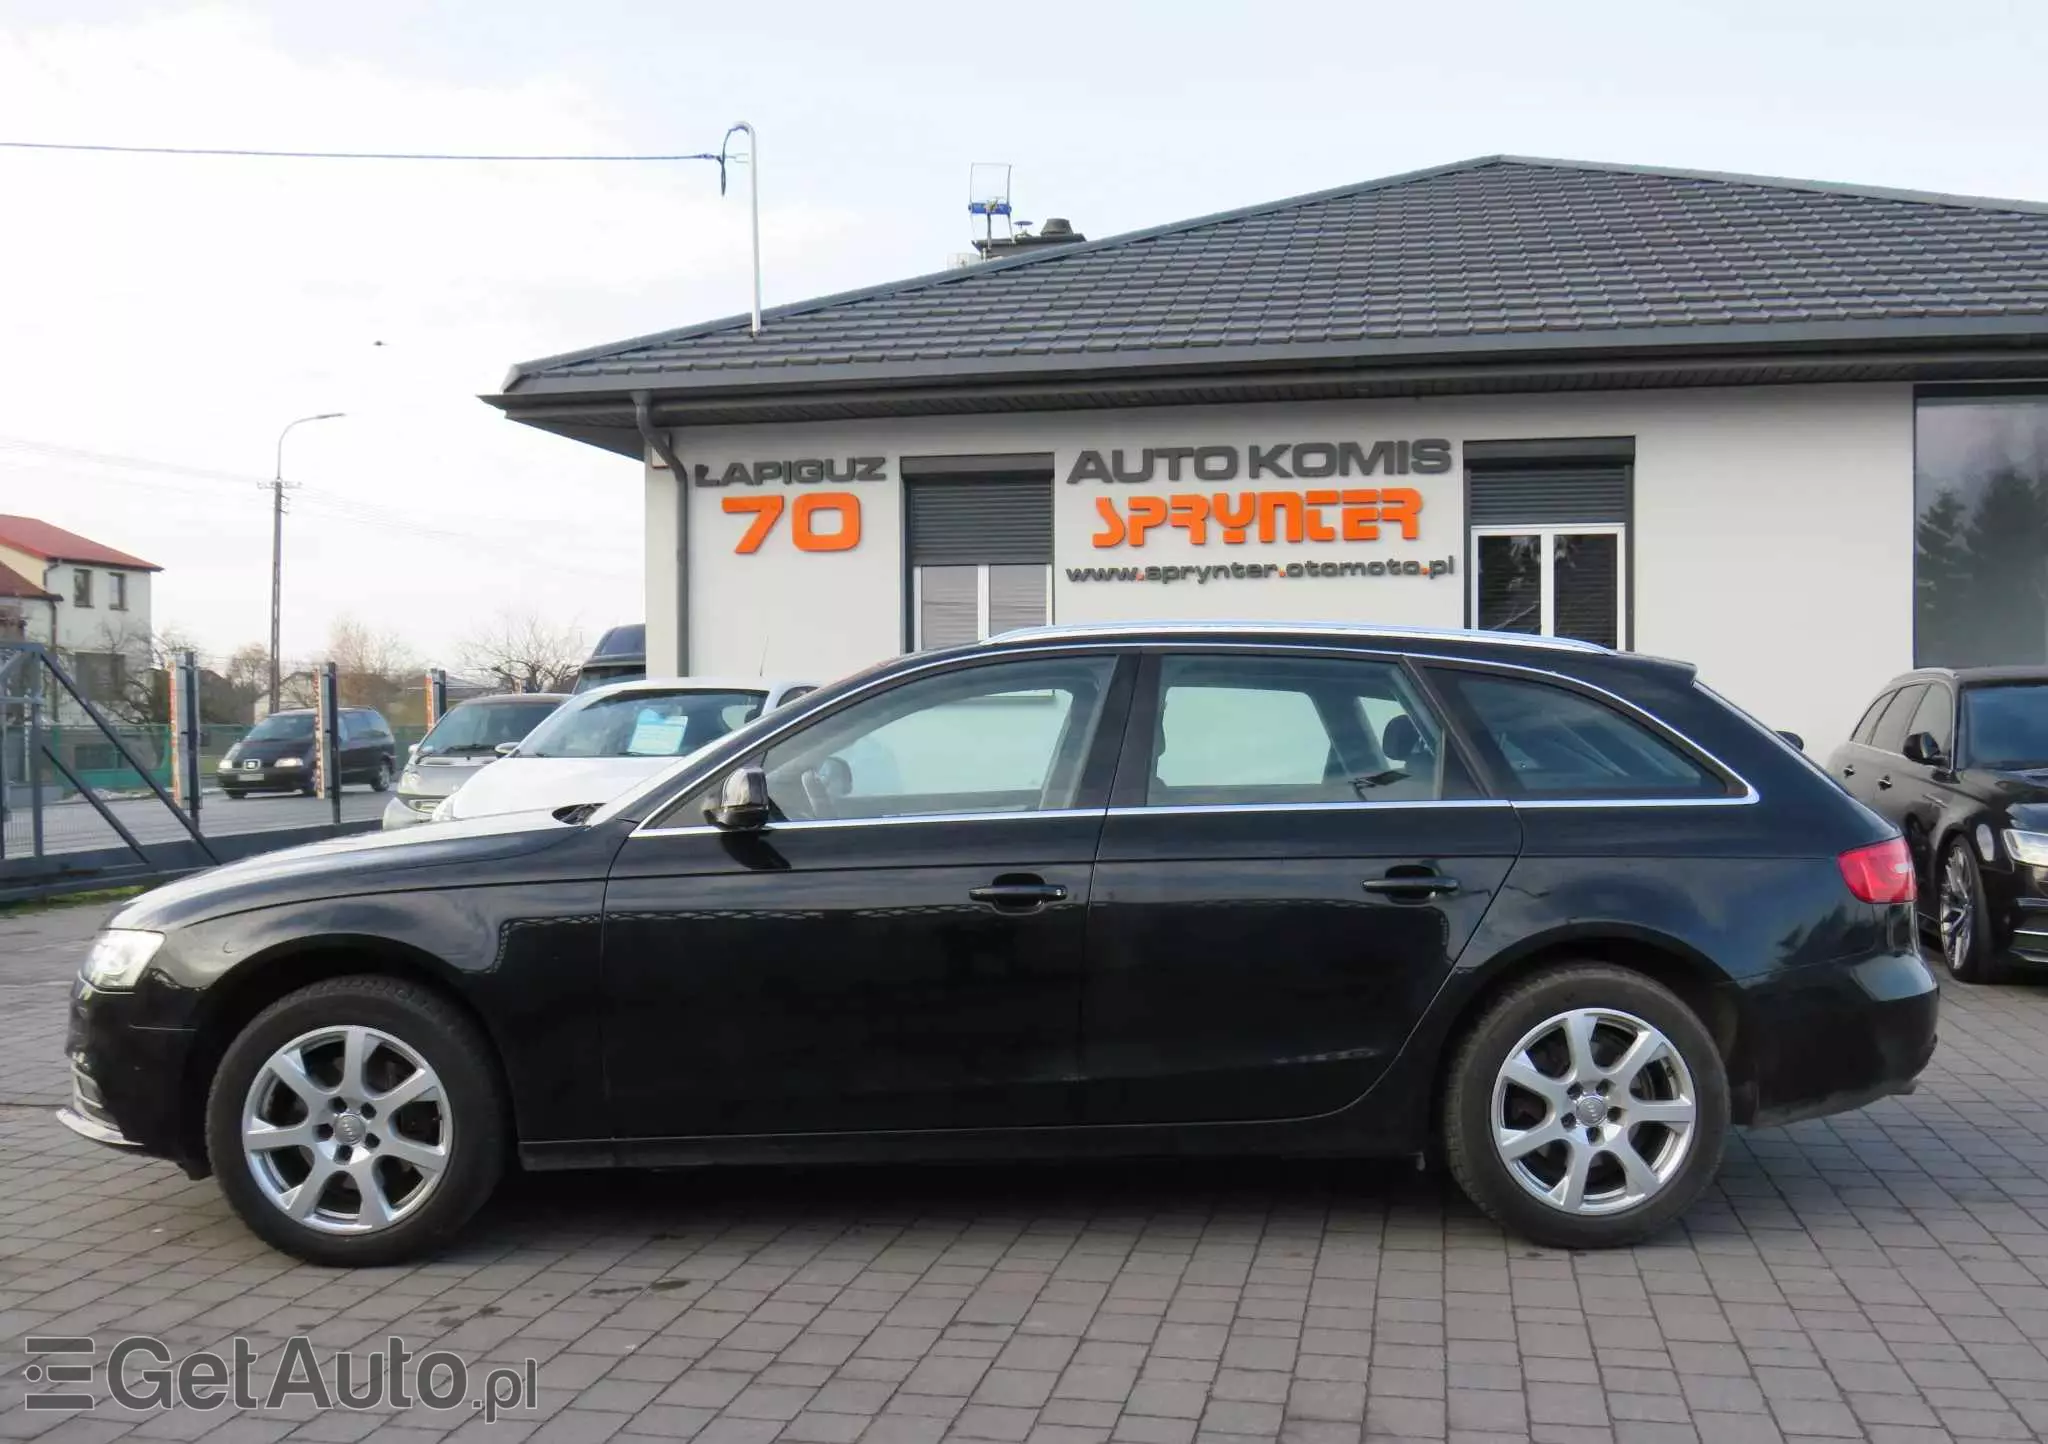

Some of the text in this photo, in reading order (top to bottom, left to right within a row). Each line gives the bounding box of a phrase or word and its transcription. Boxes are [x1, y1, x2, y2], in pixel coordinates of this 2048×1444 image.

[1067, 438, 1453, 484] AUTO KOMIS
[722, 492, 861, 554] 70
[1092, 487, 1423, 548] SPRYNTER
[1066, 556, 1454, 584] www.sprynter.otomoto.pl
